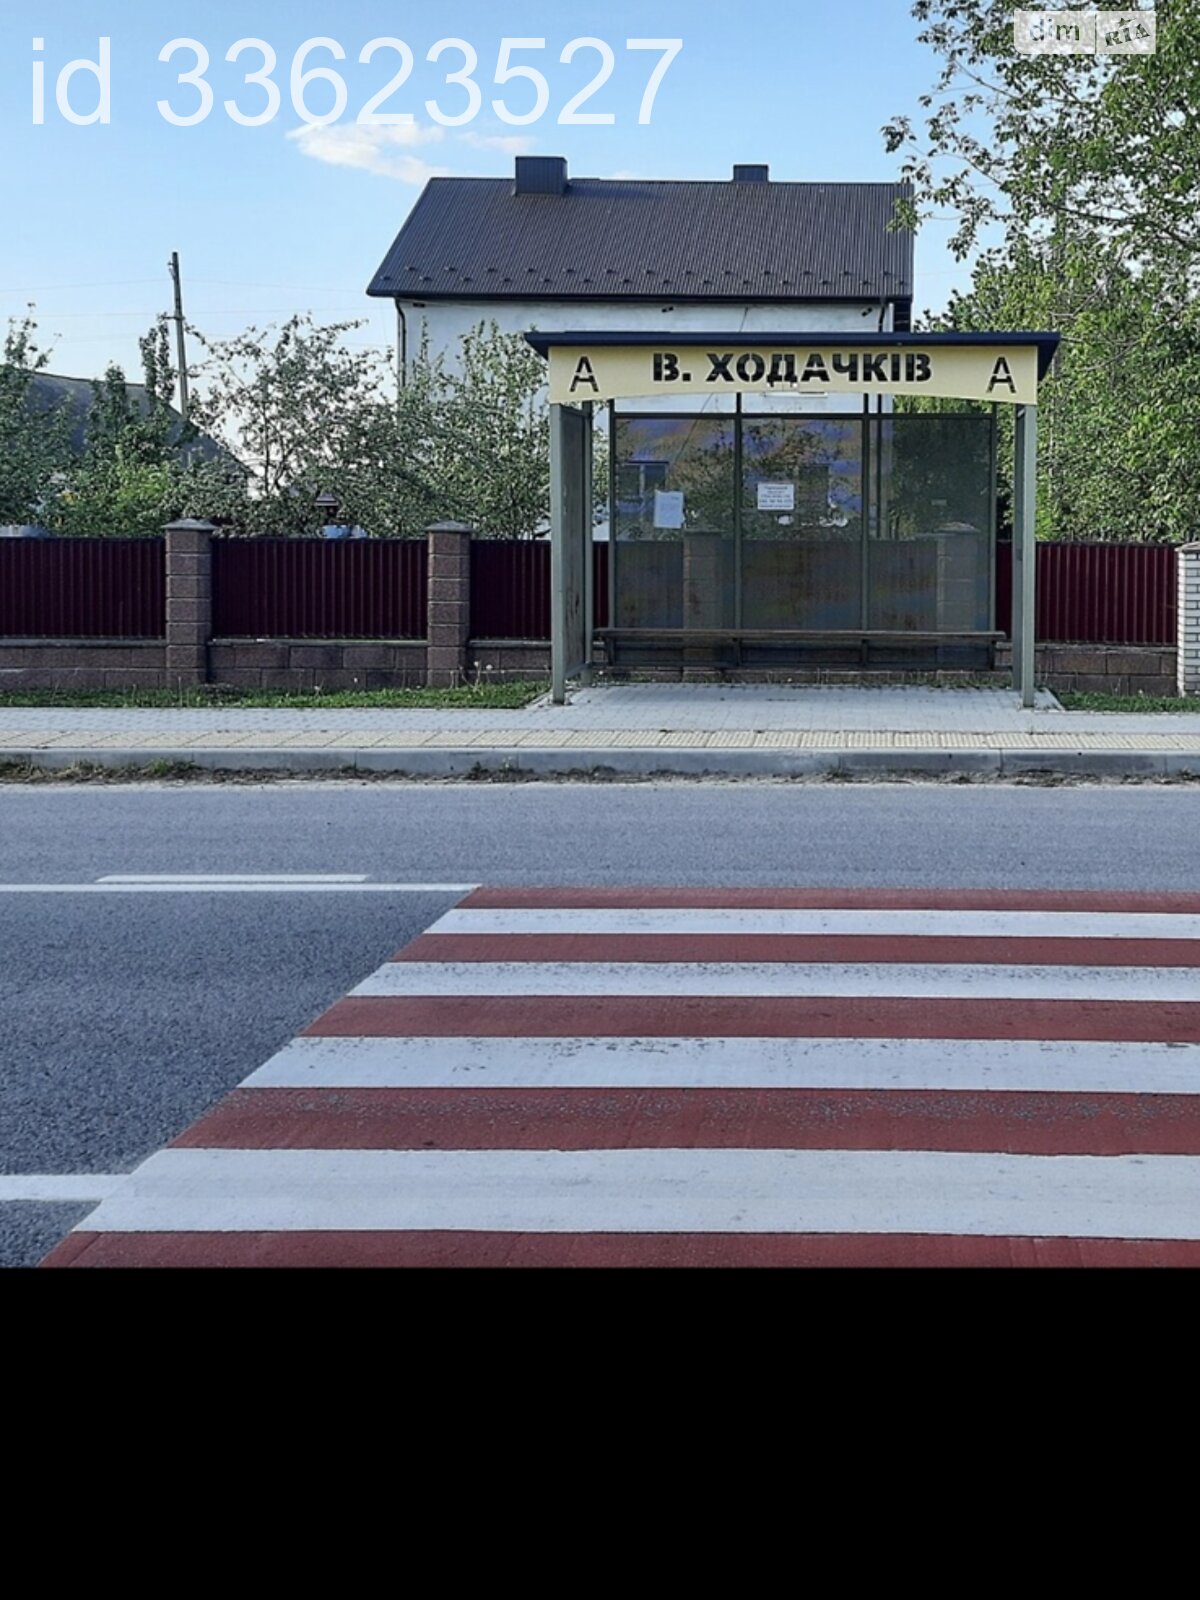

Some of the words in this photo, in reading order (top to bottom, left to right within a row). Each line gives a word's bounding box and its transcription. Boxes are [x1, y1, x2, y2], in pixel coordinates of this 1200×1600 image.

[570, 356, 599, 393] А
[653, 353, 692, 382] В.
[707, 353, 932, 387] ХОДАЧКІВ
[987, 357, 1016, 394] А
